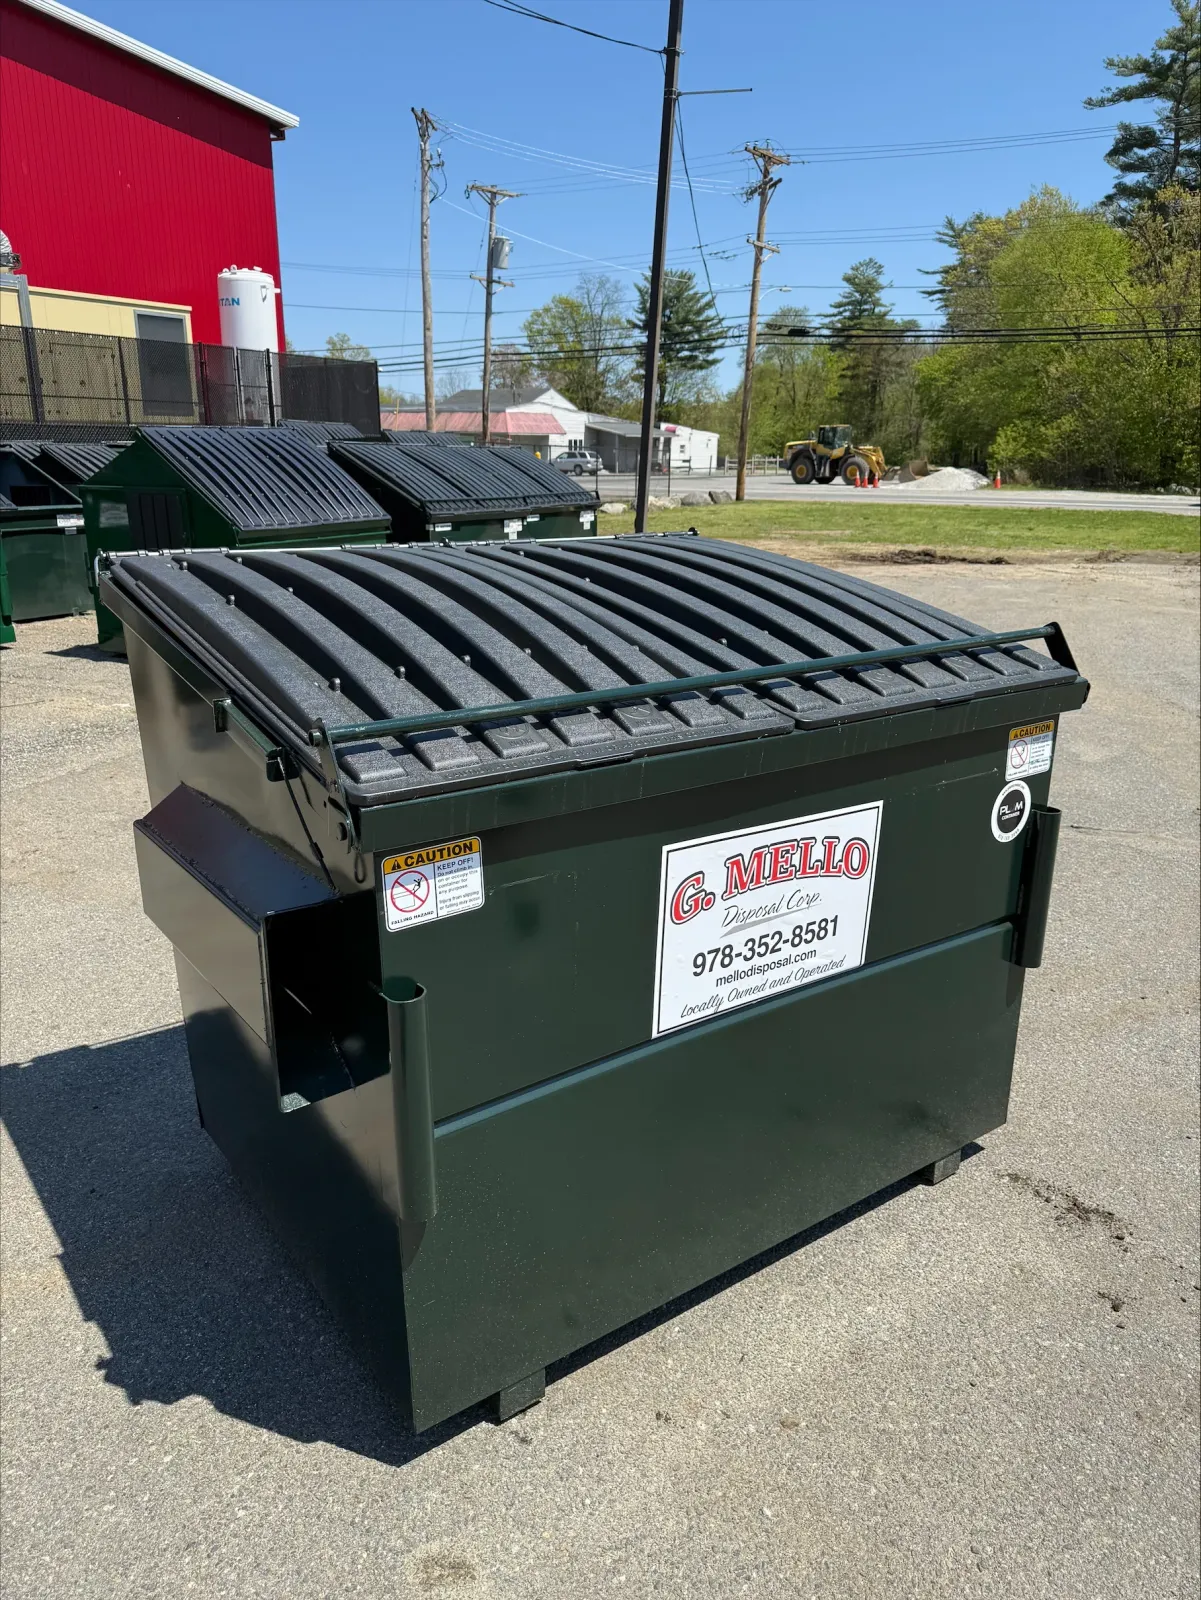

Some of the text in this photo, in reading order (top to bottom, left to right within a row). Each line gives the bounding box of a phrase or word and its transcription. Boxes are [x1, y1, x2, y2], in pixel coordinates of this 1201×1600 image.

[1020, 723, 1050, 737] CAUTION
[1000, 801, 1023, 816] PLM
[404, 841, 473, 867] CAUTION
[437, 857, 474, 871] KEEP OFF!
[670, 835, 870, 925] G. MELLO
[391, 910, 434, 925] FALLING HAZARD
[721, 887, 822, 928] Disposal Corp.
[692, 915, 838, 977] 978-352-8581
[715, 949, 817, 988] mellodisposal.com
[680, 955, 847, 1018] Locally Owned and Operated
